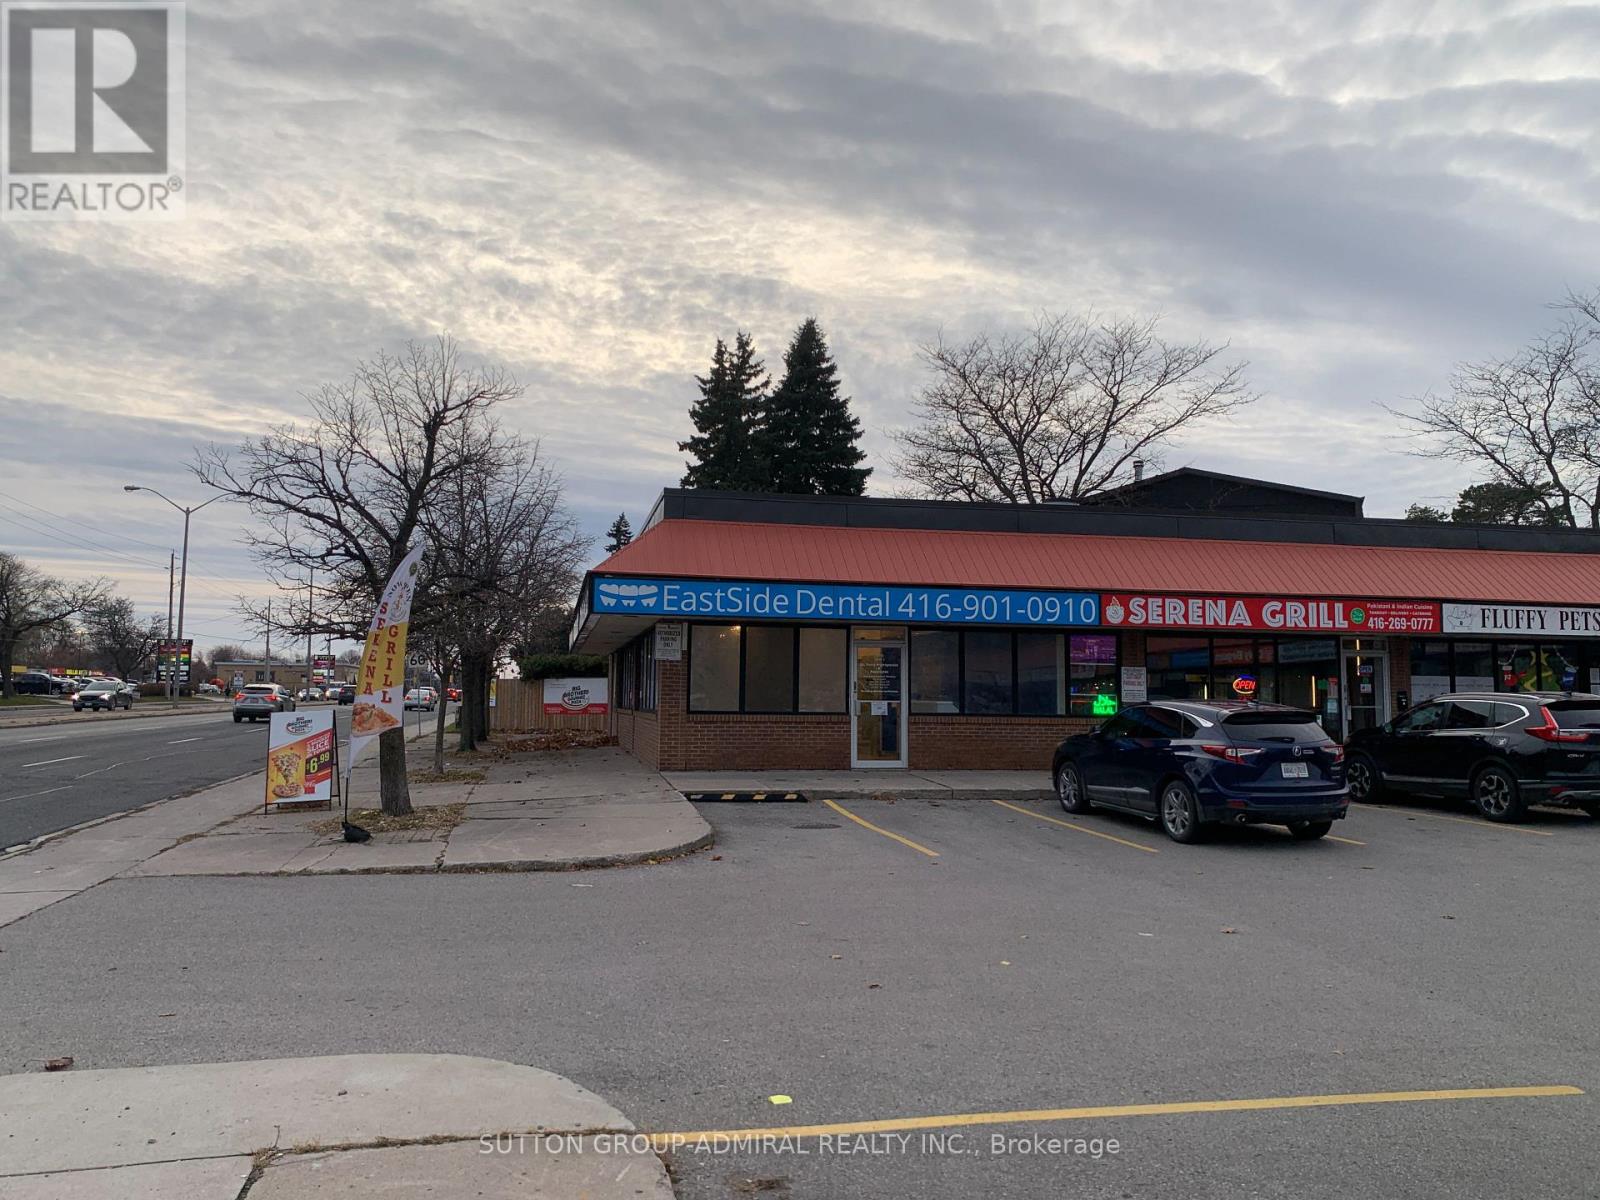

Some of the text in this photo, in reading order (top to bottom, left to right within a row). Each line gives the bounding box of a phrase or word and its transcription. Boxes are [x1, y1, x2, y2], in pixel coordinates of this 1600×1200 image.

[663, 584, 1097, 623] EastSide Dental 416-901-0910
[1128, 597, 1349, 628] SERENA GRILL
[1367, 616, 1434, 631] 416-269-0777
[1480, 608, 1600, 631] FLUFFY PETS
[380, 624, 399, 704] GRILL
[1234, 680, 1256, 690] OPEN
